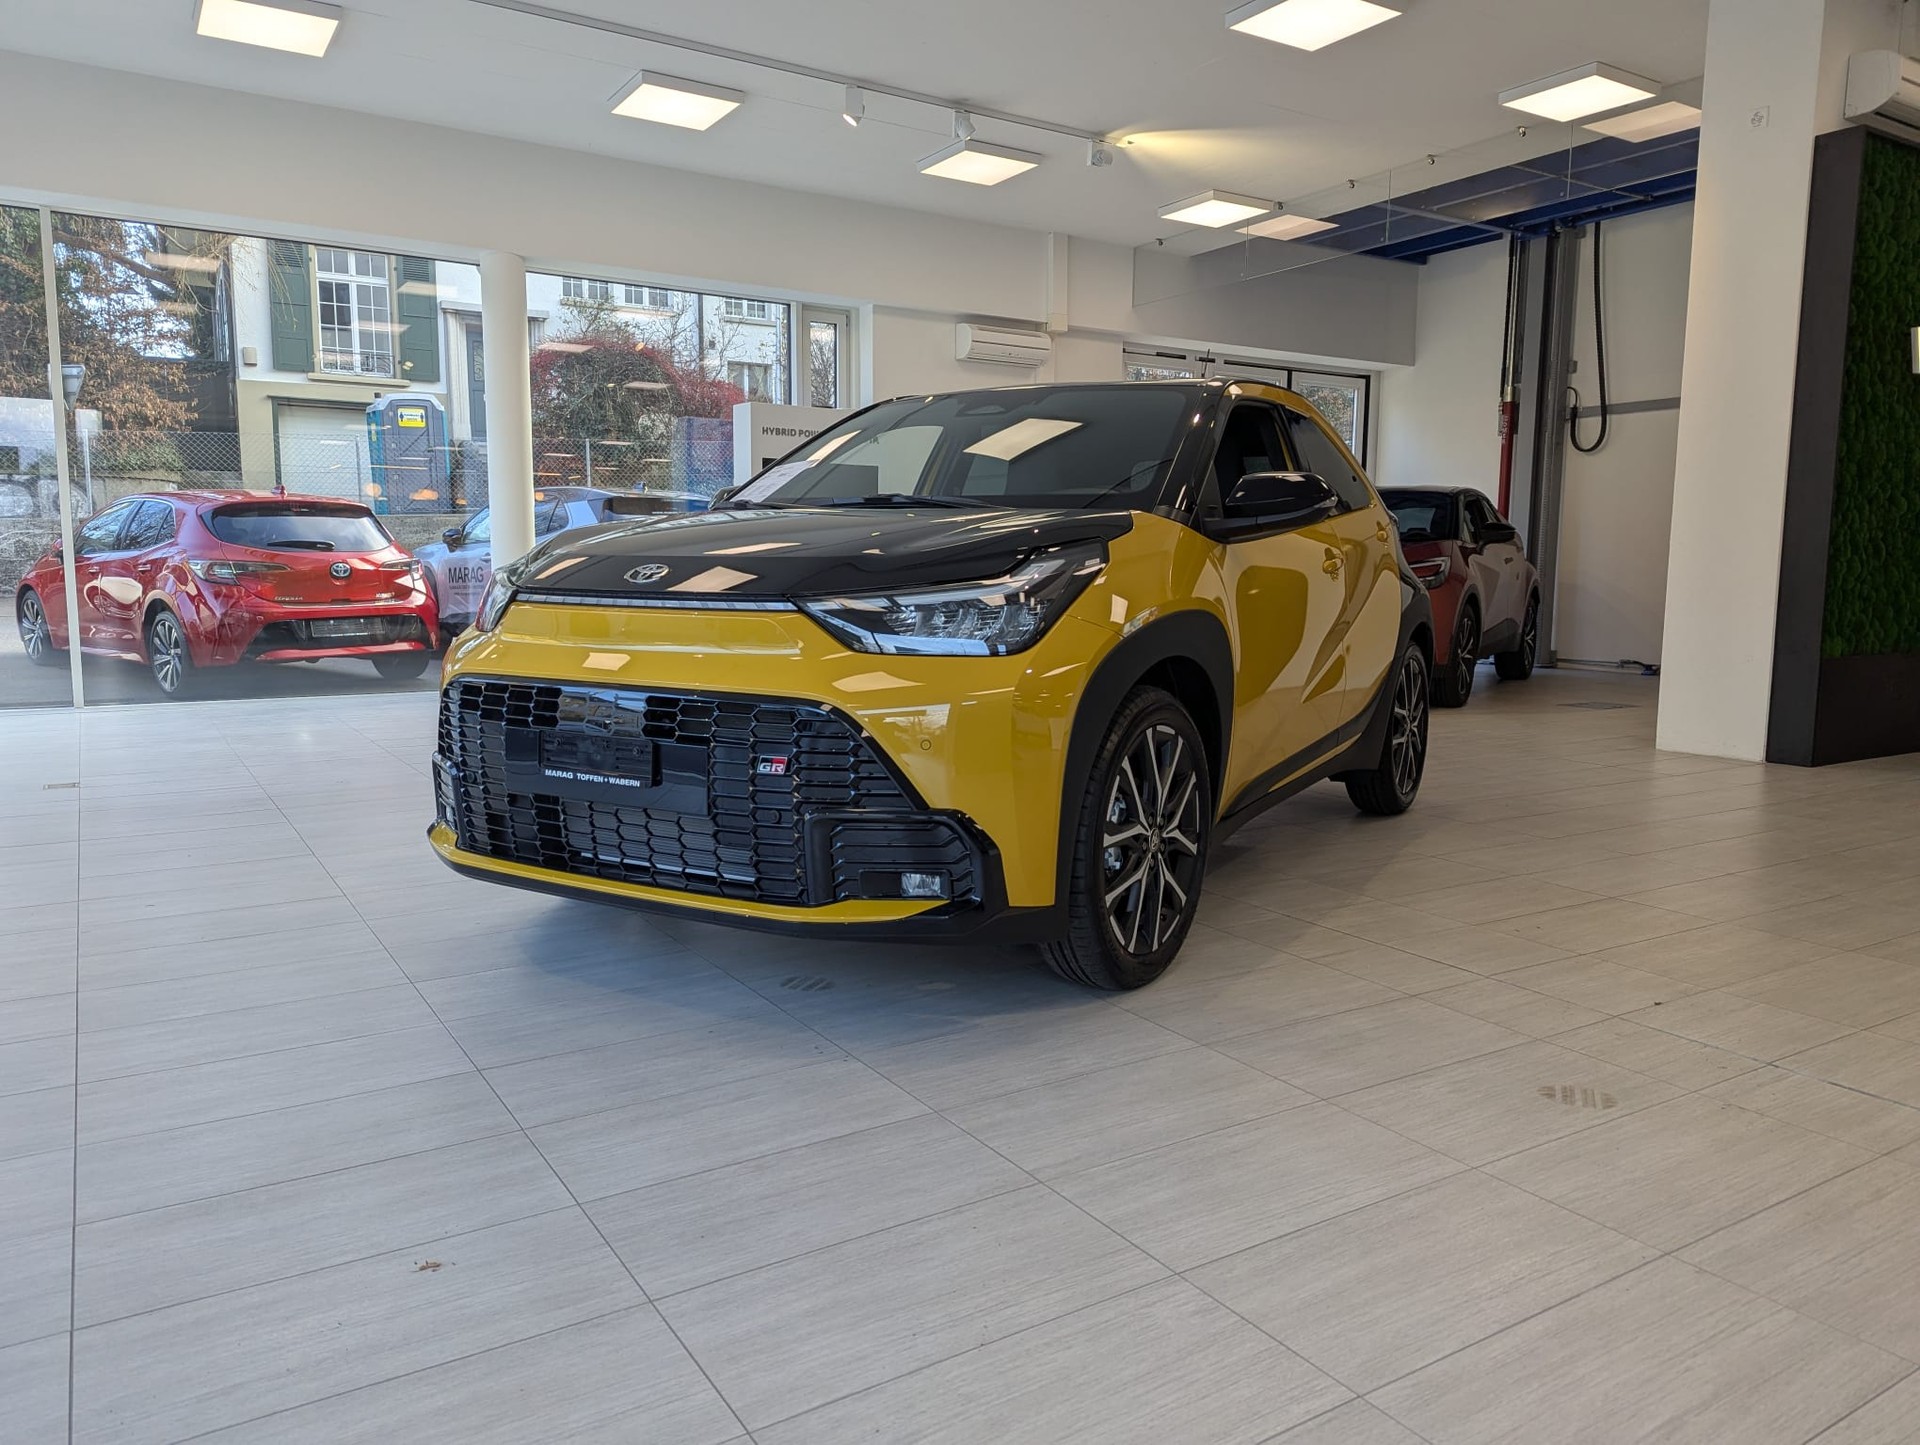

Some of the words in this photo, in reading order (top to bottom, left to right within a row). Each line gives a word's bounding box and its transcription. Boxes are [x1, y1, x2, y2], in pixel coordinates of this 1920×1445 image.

[762, 426, 797, 437] HYBRID
[448, 566, 484, 583] MARAG
[759, 763, 784, 772] GR
[545, 769, 573, 779] MARAG
[577, 773, 603, 783] TOFFEN
[609, 777, 640, 787] WABERN
